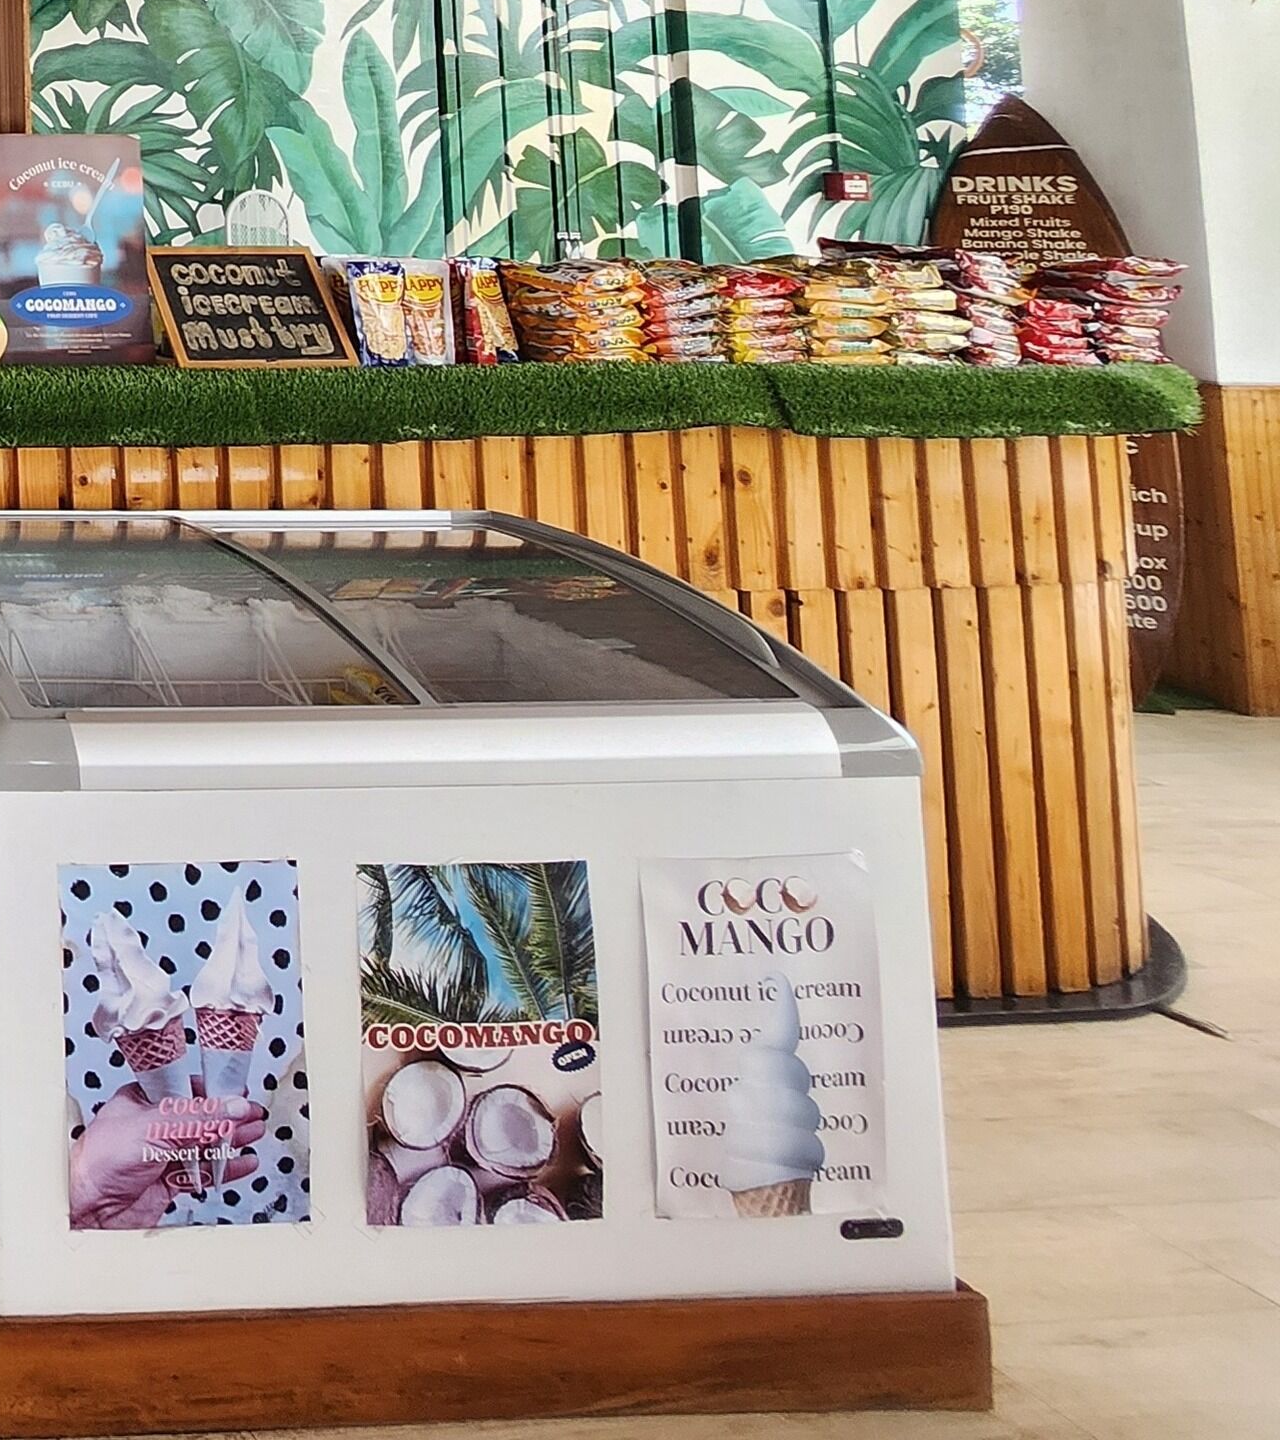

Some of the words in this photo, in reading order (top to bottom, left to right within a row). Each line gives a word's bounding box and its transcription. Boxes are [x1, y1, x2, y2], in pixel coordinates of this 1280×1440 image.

[8, 159, 57, 191] Coconut
[58, 157, 78, 170] ice
[951, 175, 1079, 193] DRINKS
[956, 194, 1010, 205] FRUIT
[1011, 194, 1077, 205] SHAKE
[969, 217, 1020, 227] Mixed
[1024, 217, 1072, 227] Fruits
[964, 229, 1023, 240] Mango
[1026, 229, 1082, 239] Shake
[961, 239, 1029, 249] Banana
[1031, 239, 1087, 250] Shake
[25, 298, 118, 312] COCOMANGO
[697, 875, 818, 916] COCO
[678, 916, 835, 956] MANGO
[661, 982, 752, 1004] Coconut
[757, 983, 777, 1002] ic
[794, 982, 862, 1001] cream
[367, 1020, 595, 1051] COCOMANGO
[557, 1046, 588, 1066] OPEN
[810, 1071, 866, 1090] ream
[160, 1096, 218, 1115] coco
[145, 1119, 234, 1144] mango
[667, 1118, 726, 1138] ream
[142, 1146, 200, 1162] Dessert
[816, 1164, 872, 1183] ream
